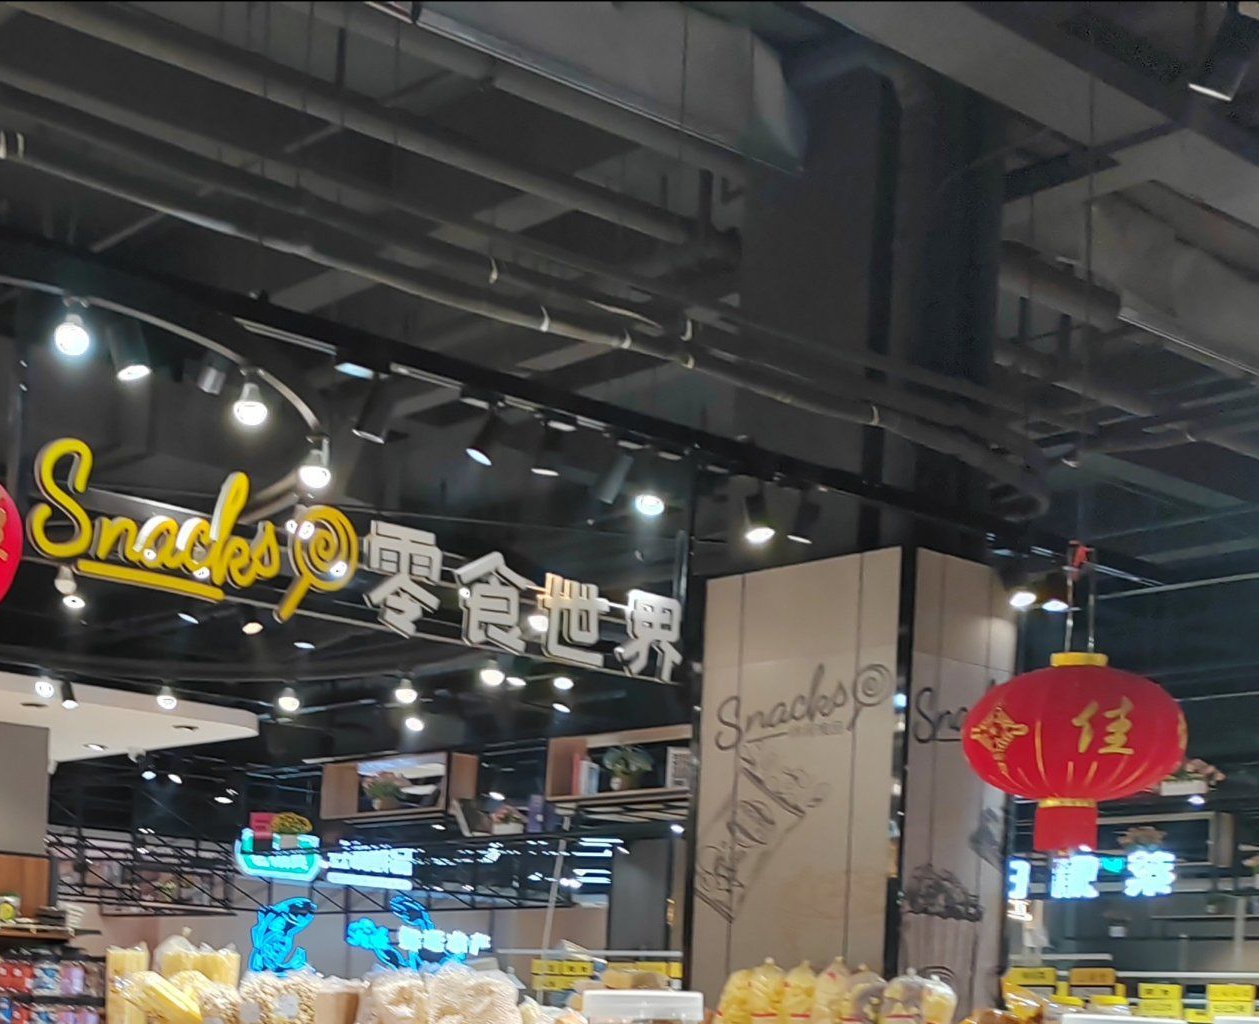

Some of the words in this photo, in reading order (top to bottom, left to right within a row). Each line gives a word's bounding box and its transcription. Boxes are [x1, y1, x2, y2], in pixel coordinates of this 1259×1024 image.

[28, 437, 280, 588] Snacks
[362, 519, 684, 684] 零食世界
[715, 662, 848, 751] Snacks
[1072, 697, 1135, 756] 佳
